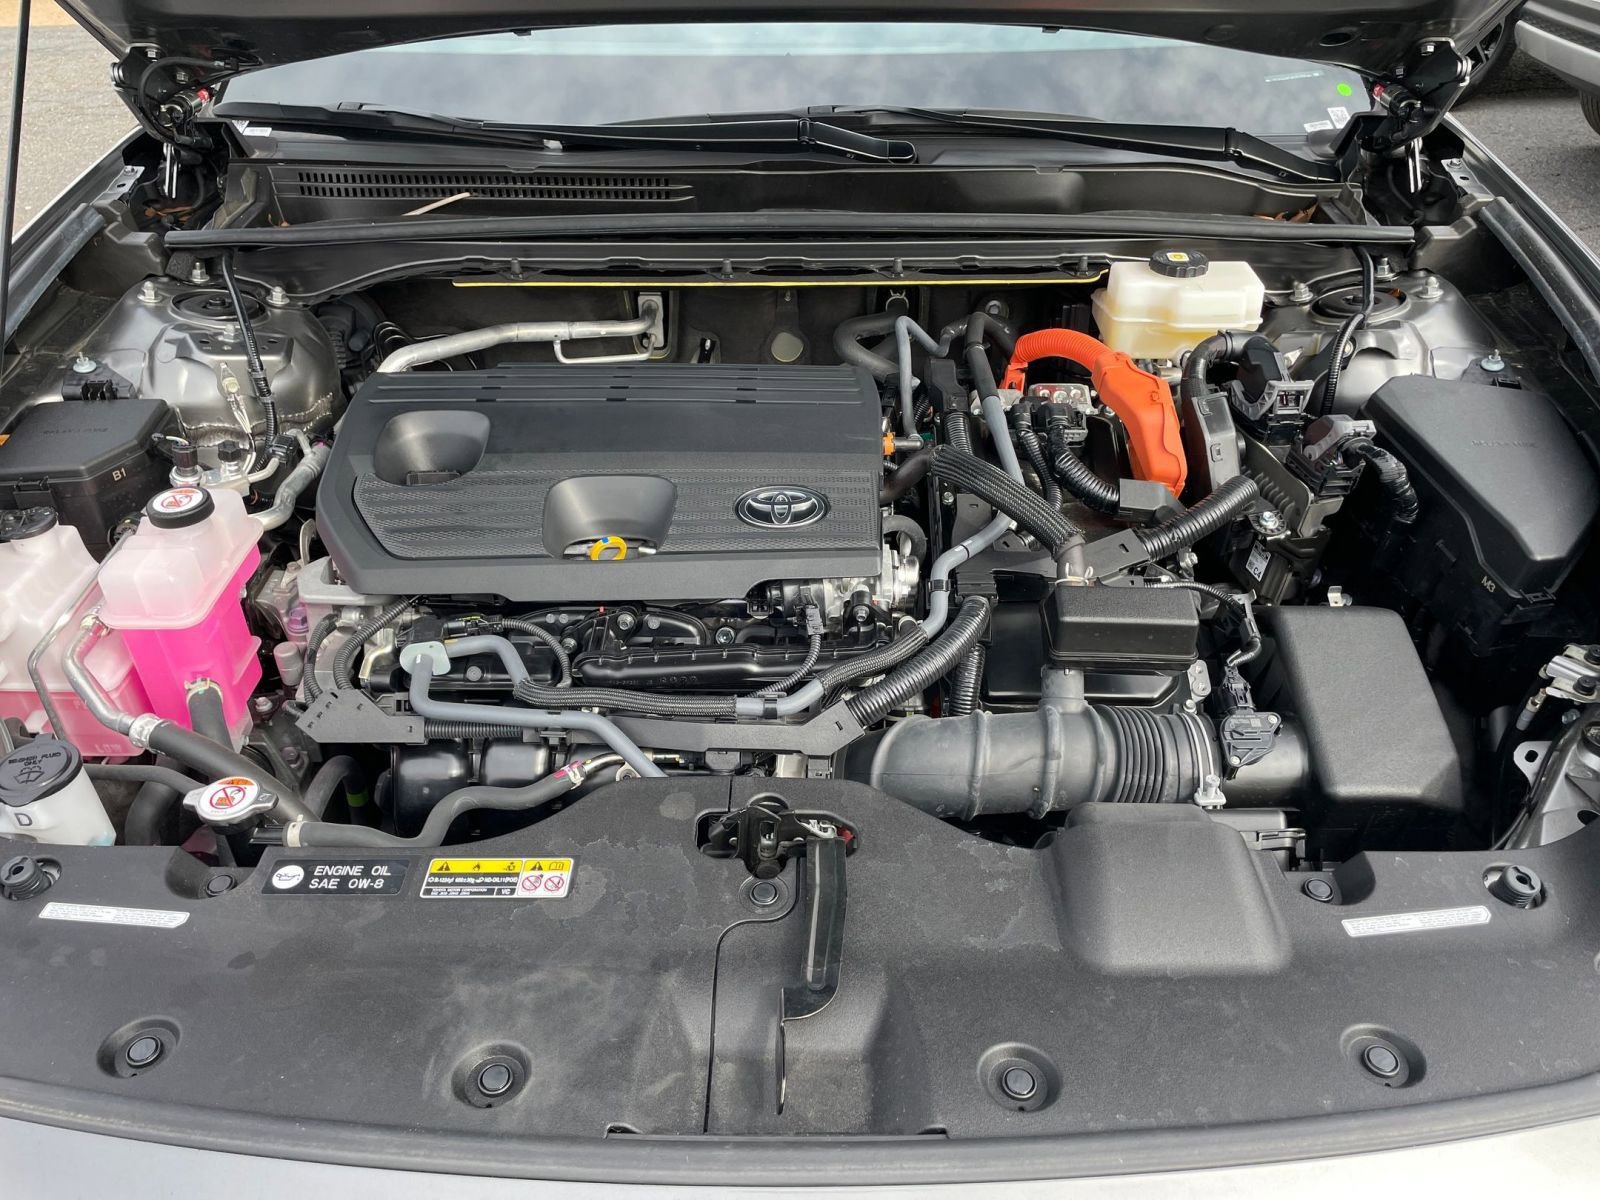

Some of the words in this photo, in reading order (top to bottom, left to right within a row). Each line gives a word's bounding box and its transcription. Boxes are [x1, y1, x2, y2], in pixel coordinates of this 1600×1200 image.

[112, 467, 126, 481] B1
[1481, 575, 1496, 593] M3
[24, 759, 42, 767] ONLY
[314, 865, 364, 876] ENGINE
[371, 865, 392, 876] OIL
[309, 878, 340, 889] SAE
